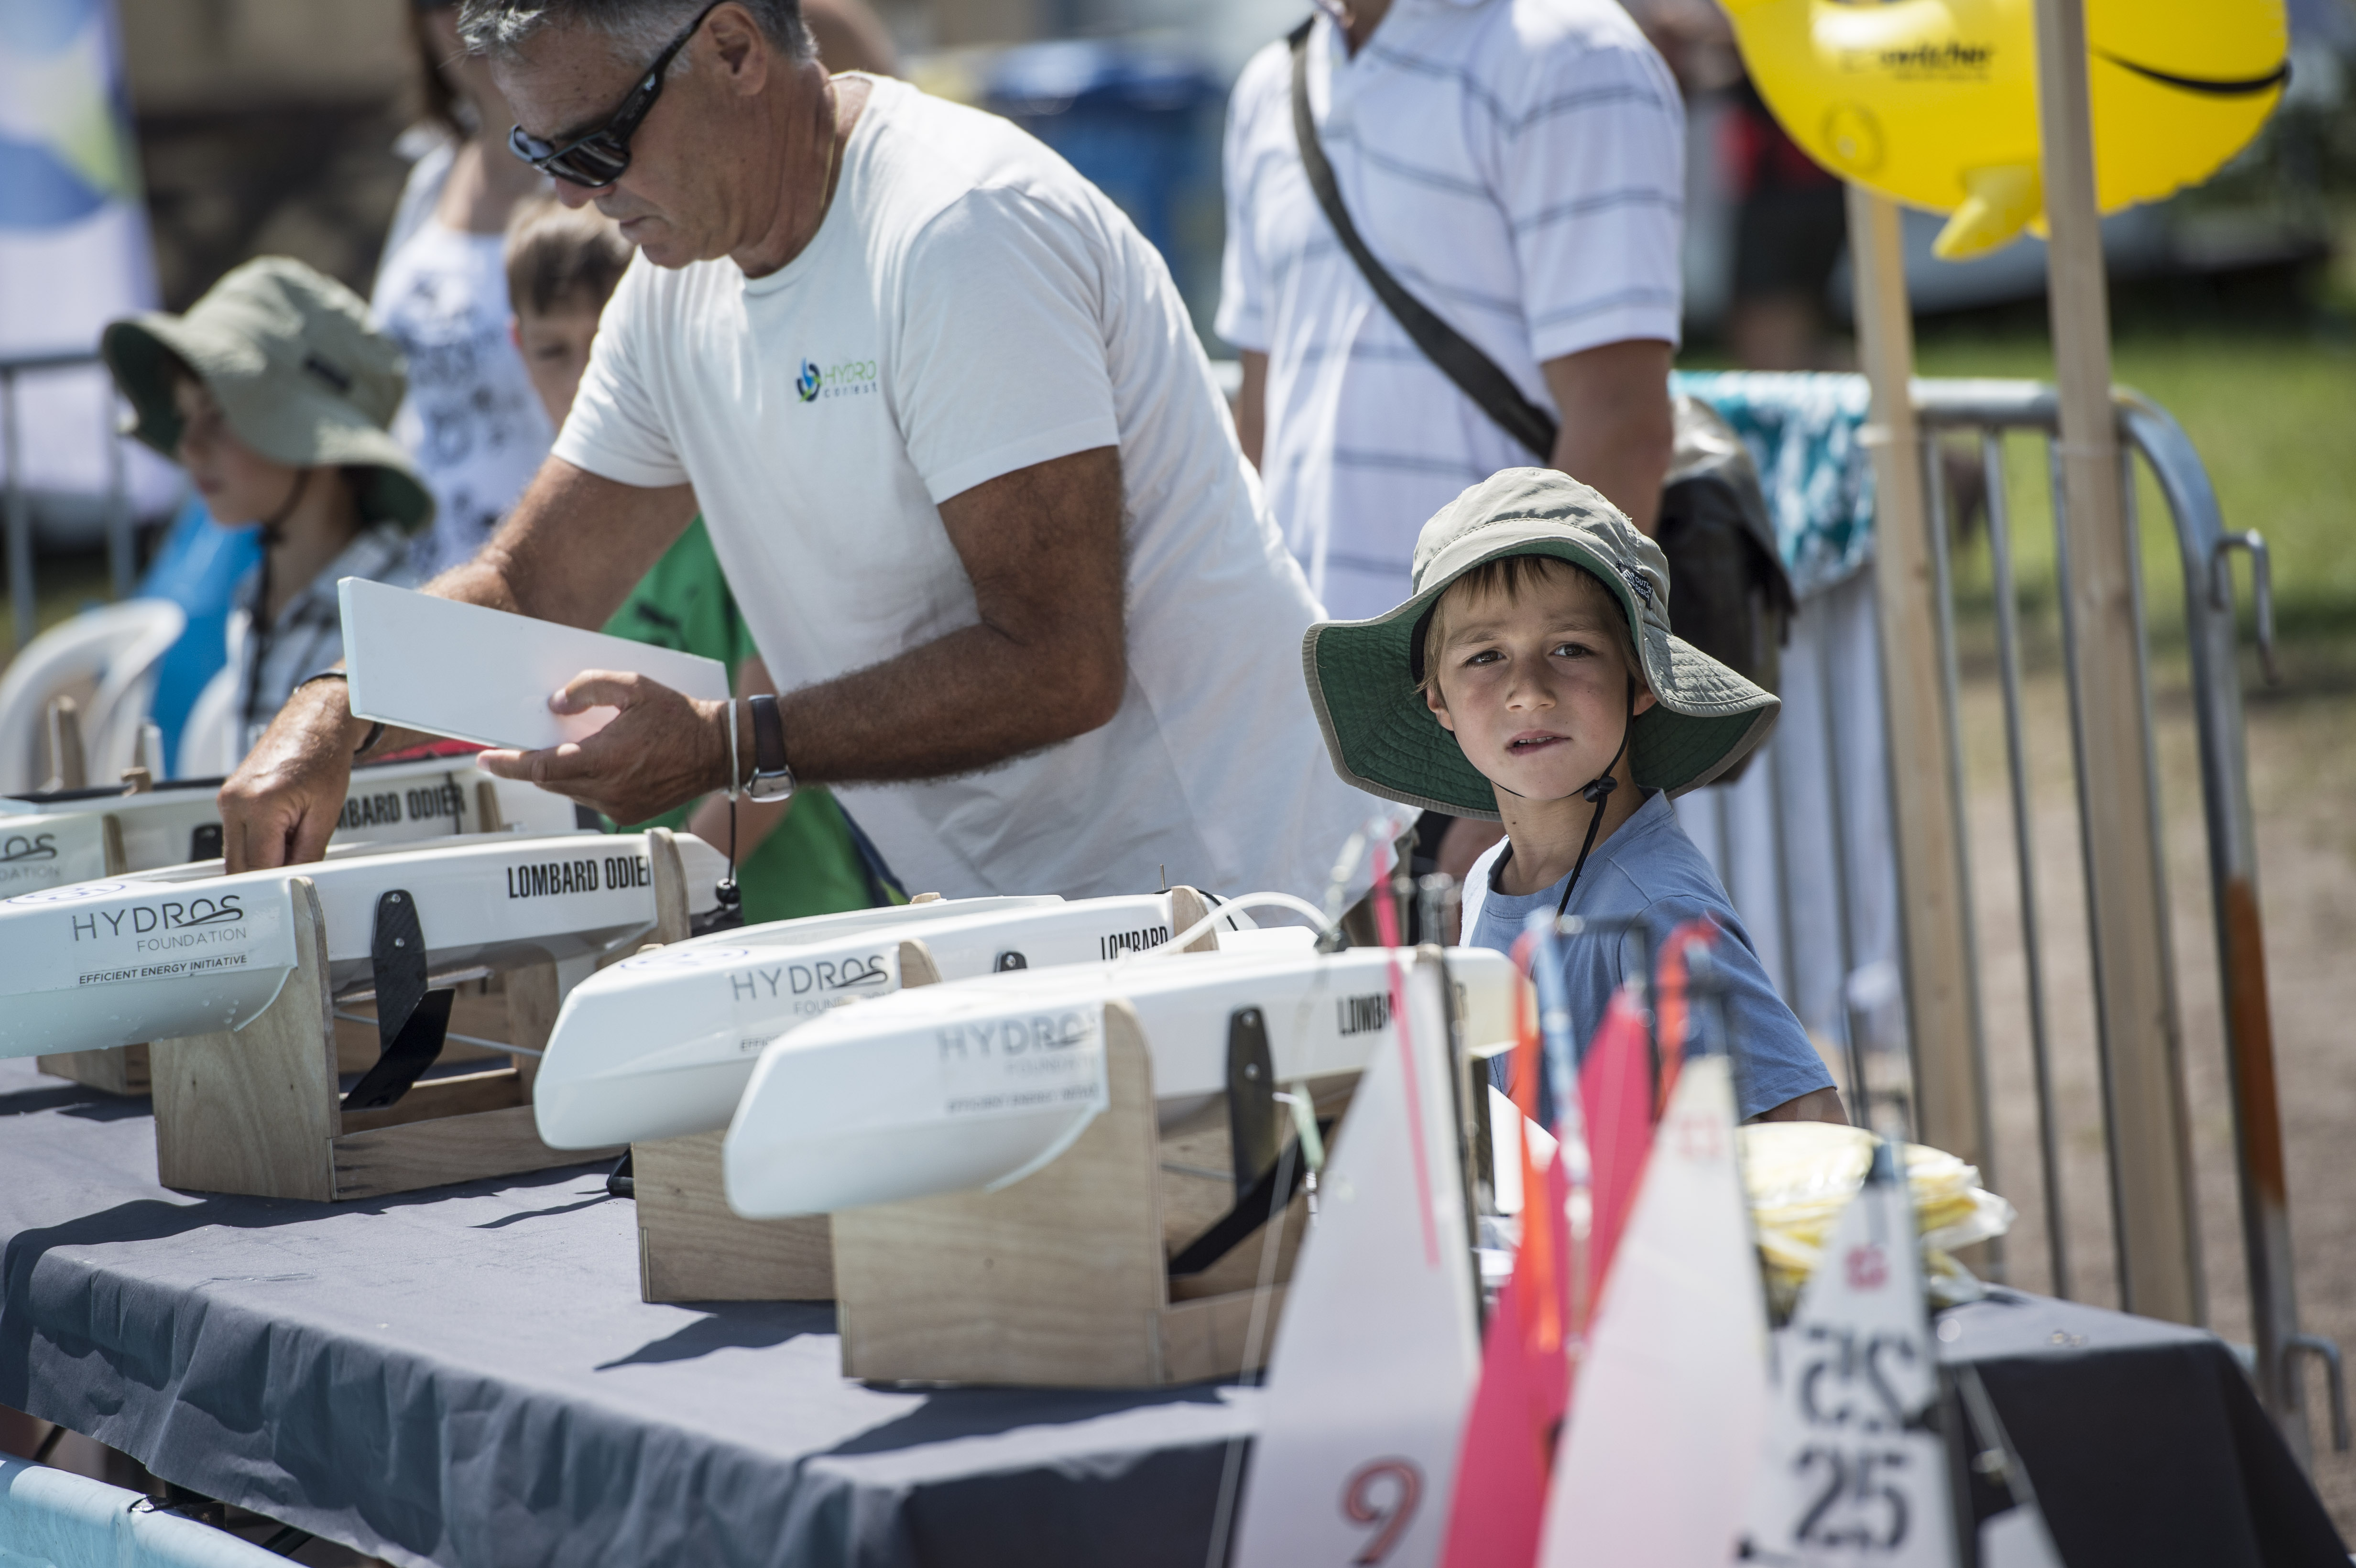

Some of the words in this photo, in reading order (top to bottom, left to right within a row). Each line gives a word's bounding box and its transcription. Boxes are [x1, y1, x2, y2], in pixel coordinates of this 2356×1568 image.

[824, 360, 877, 384] HYDRO
[507, 859, 599, 899] LOMBARD
[73, 895, 243, 941] HYDROS
[137, 927, 247, 952] FOUNDATION
[79, 969, 138, 985] EFFICIENT
[141, 963, 188, 978] ENERGY
[190, 955, 247, 970] INITIATIVE
[730, 955, 888, 1002] HYDROS
[1337, 1453, 1427, 1568] 9
[1793, 1443, 1912, 1556] 25
